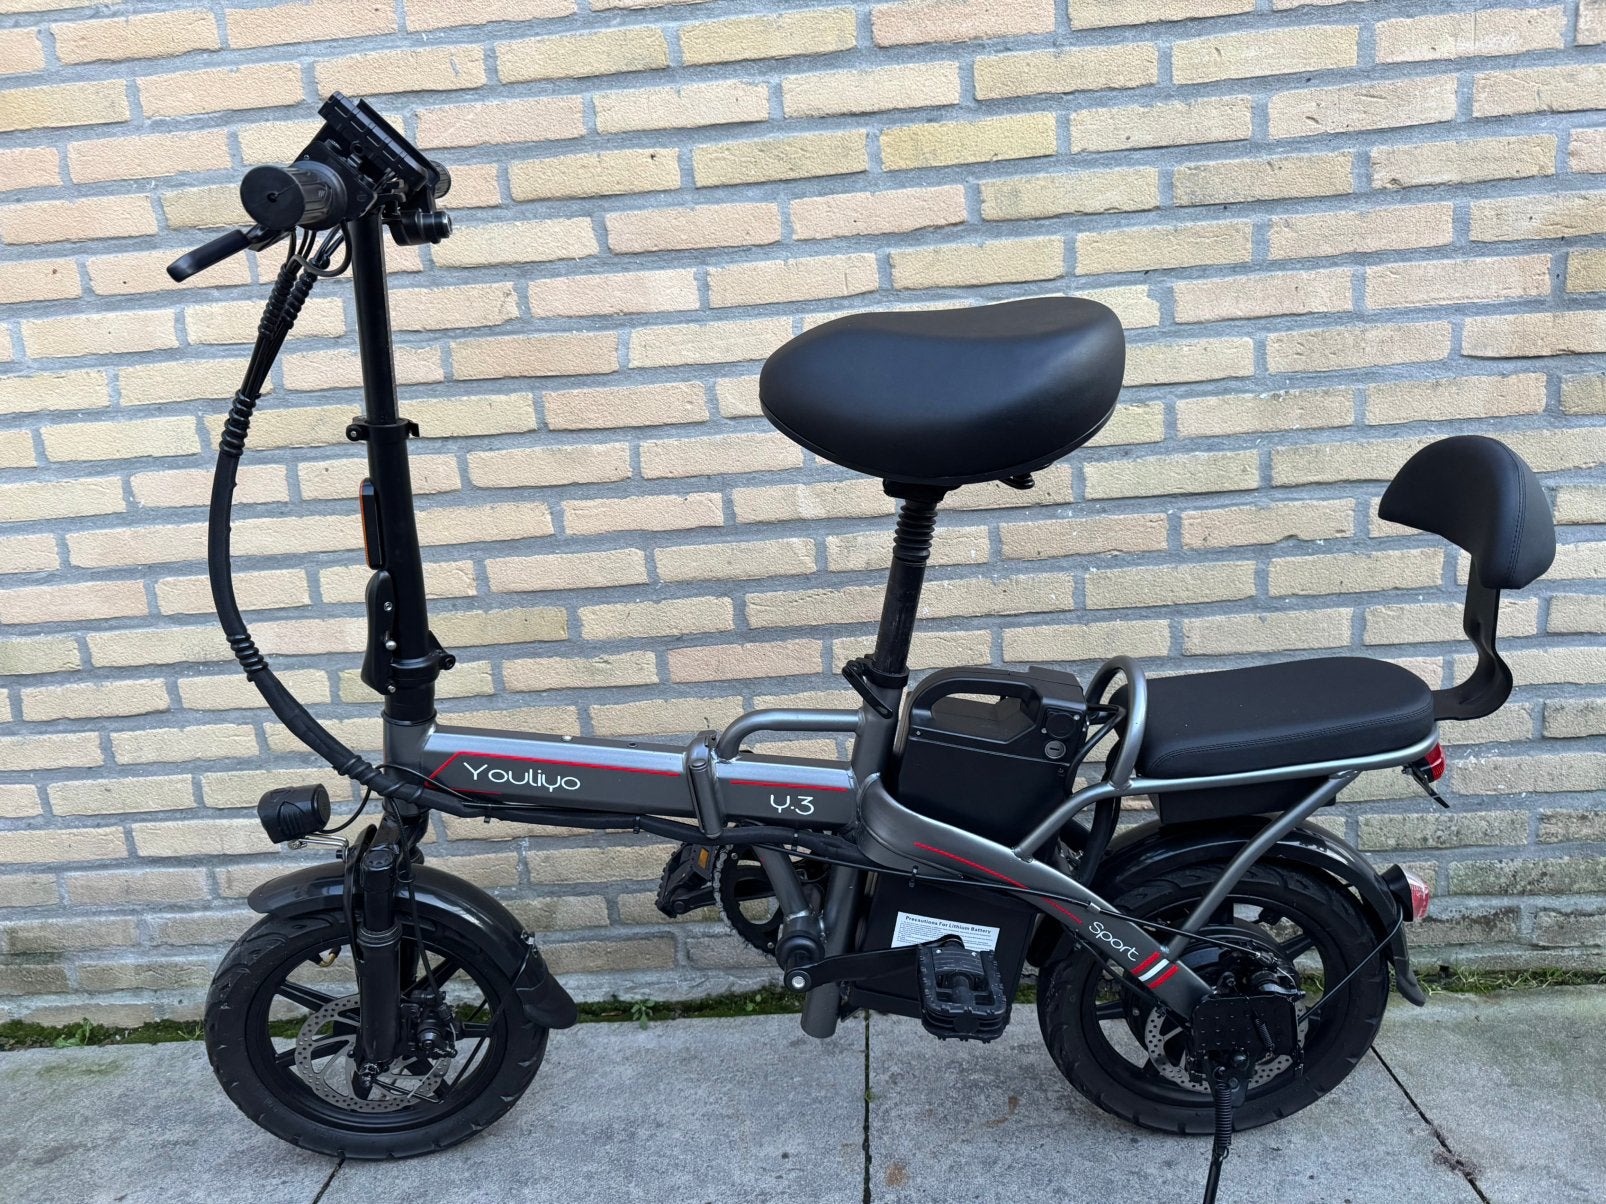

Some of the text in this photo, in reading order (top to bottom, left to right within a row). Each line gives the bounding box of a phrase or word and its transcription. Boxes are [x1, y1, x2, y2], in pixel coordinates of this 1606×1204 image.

[463, 762, 581, 792] Youliyo
[905, 915, 938, 926] Precautions
[948, 923, 970, 931] Lithium
[970, 926, 991, 934] Battery
[1089, 921, 1140, 961] Sport
